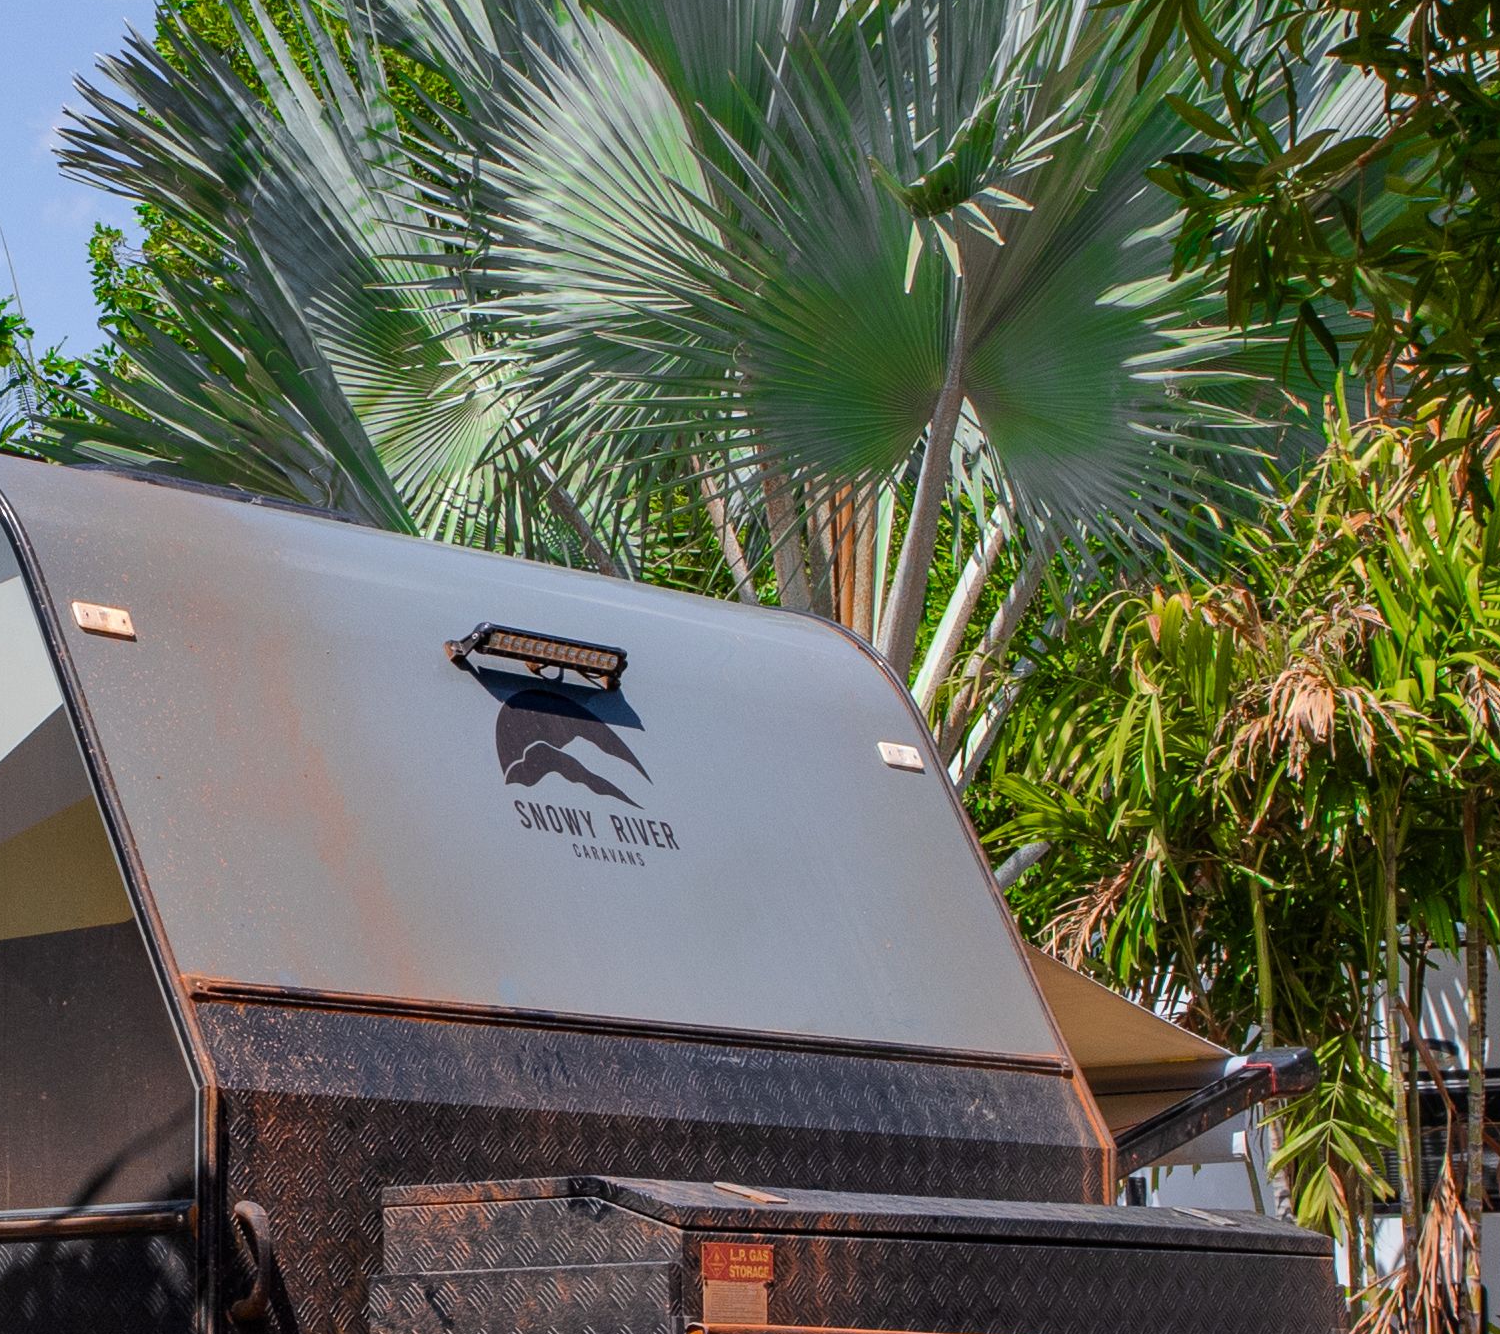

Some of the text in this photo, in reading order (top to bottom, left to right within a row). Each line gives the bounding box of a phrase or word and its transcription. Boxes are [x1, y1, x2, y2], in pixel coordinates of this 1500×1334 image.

[513, 799, 681, 851] SNOWY RIVER
[572, 843, 646, 867] CARAVANS
[729, 1248, 769, 1262] L.P. GAS
[728, 1264, 770, 1278] STORAGE
